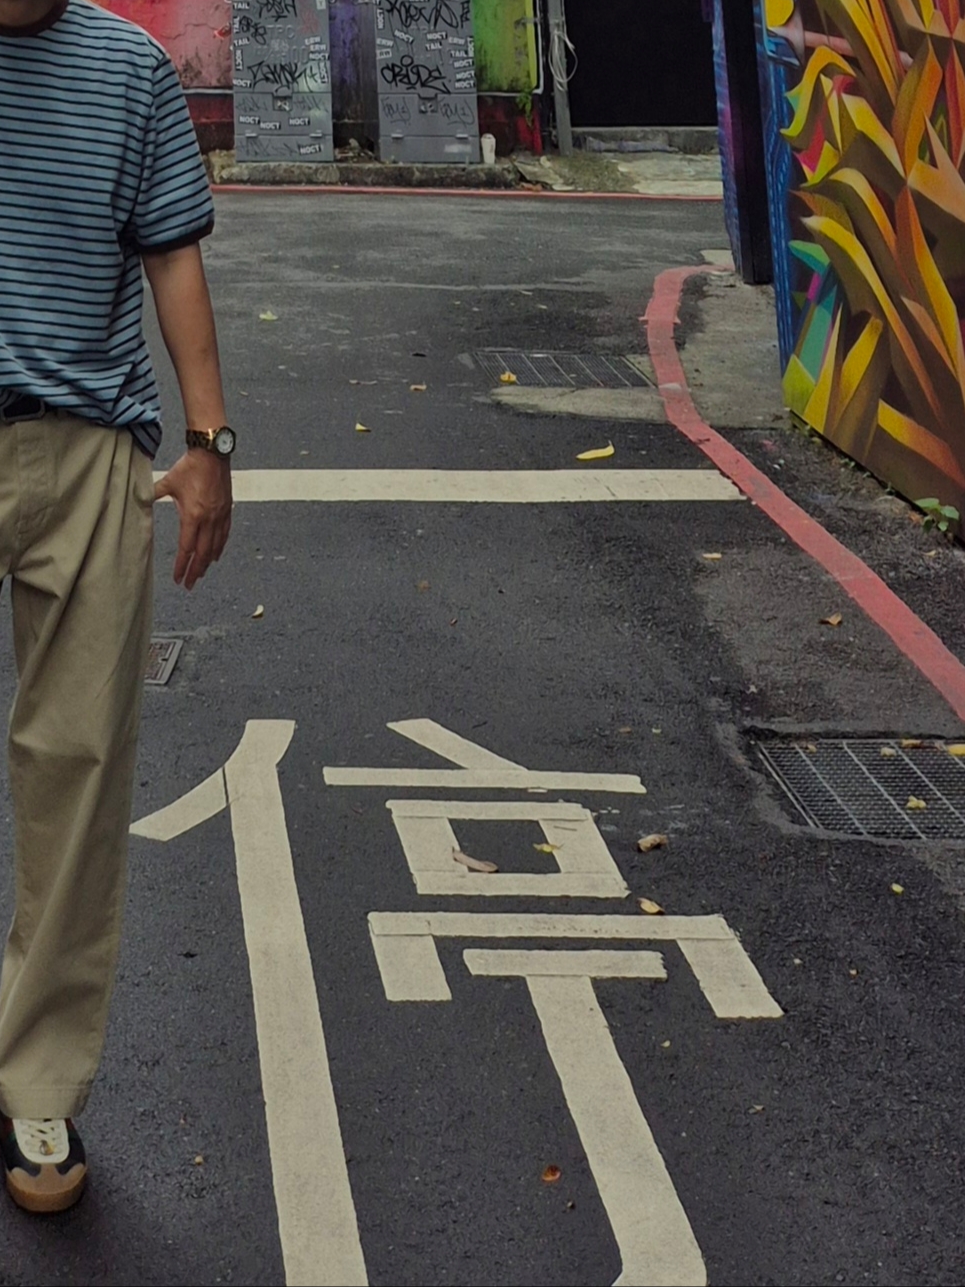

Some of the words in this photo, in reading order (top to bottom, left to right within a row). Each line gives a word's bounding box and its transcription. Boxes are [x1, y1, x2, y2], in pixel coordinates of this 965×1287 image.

[239, 115, 260, 125] NOCT
[289, 117, 310, 126] NOCT
[259, 121, 280, 130] NOCT
[130, 717, 785, 1287] 停
